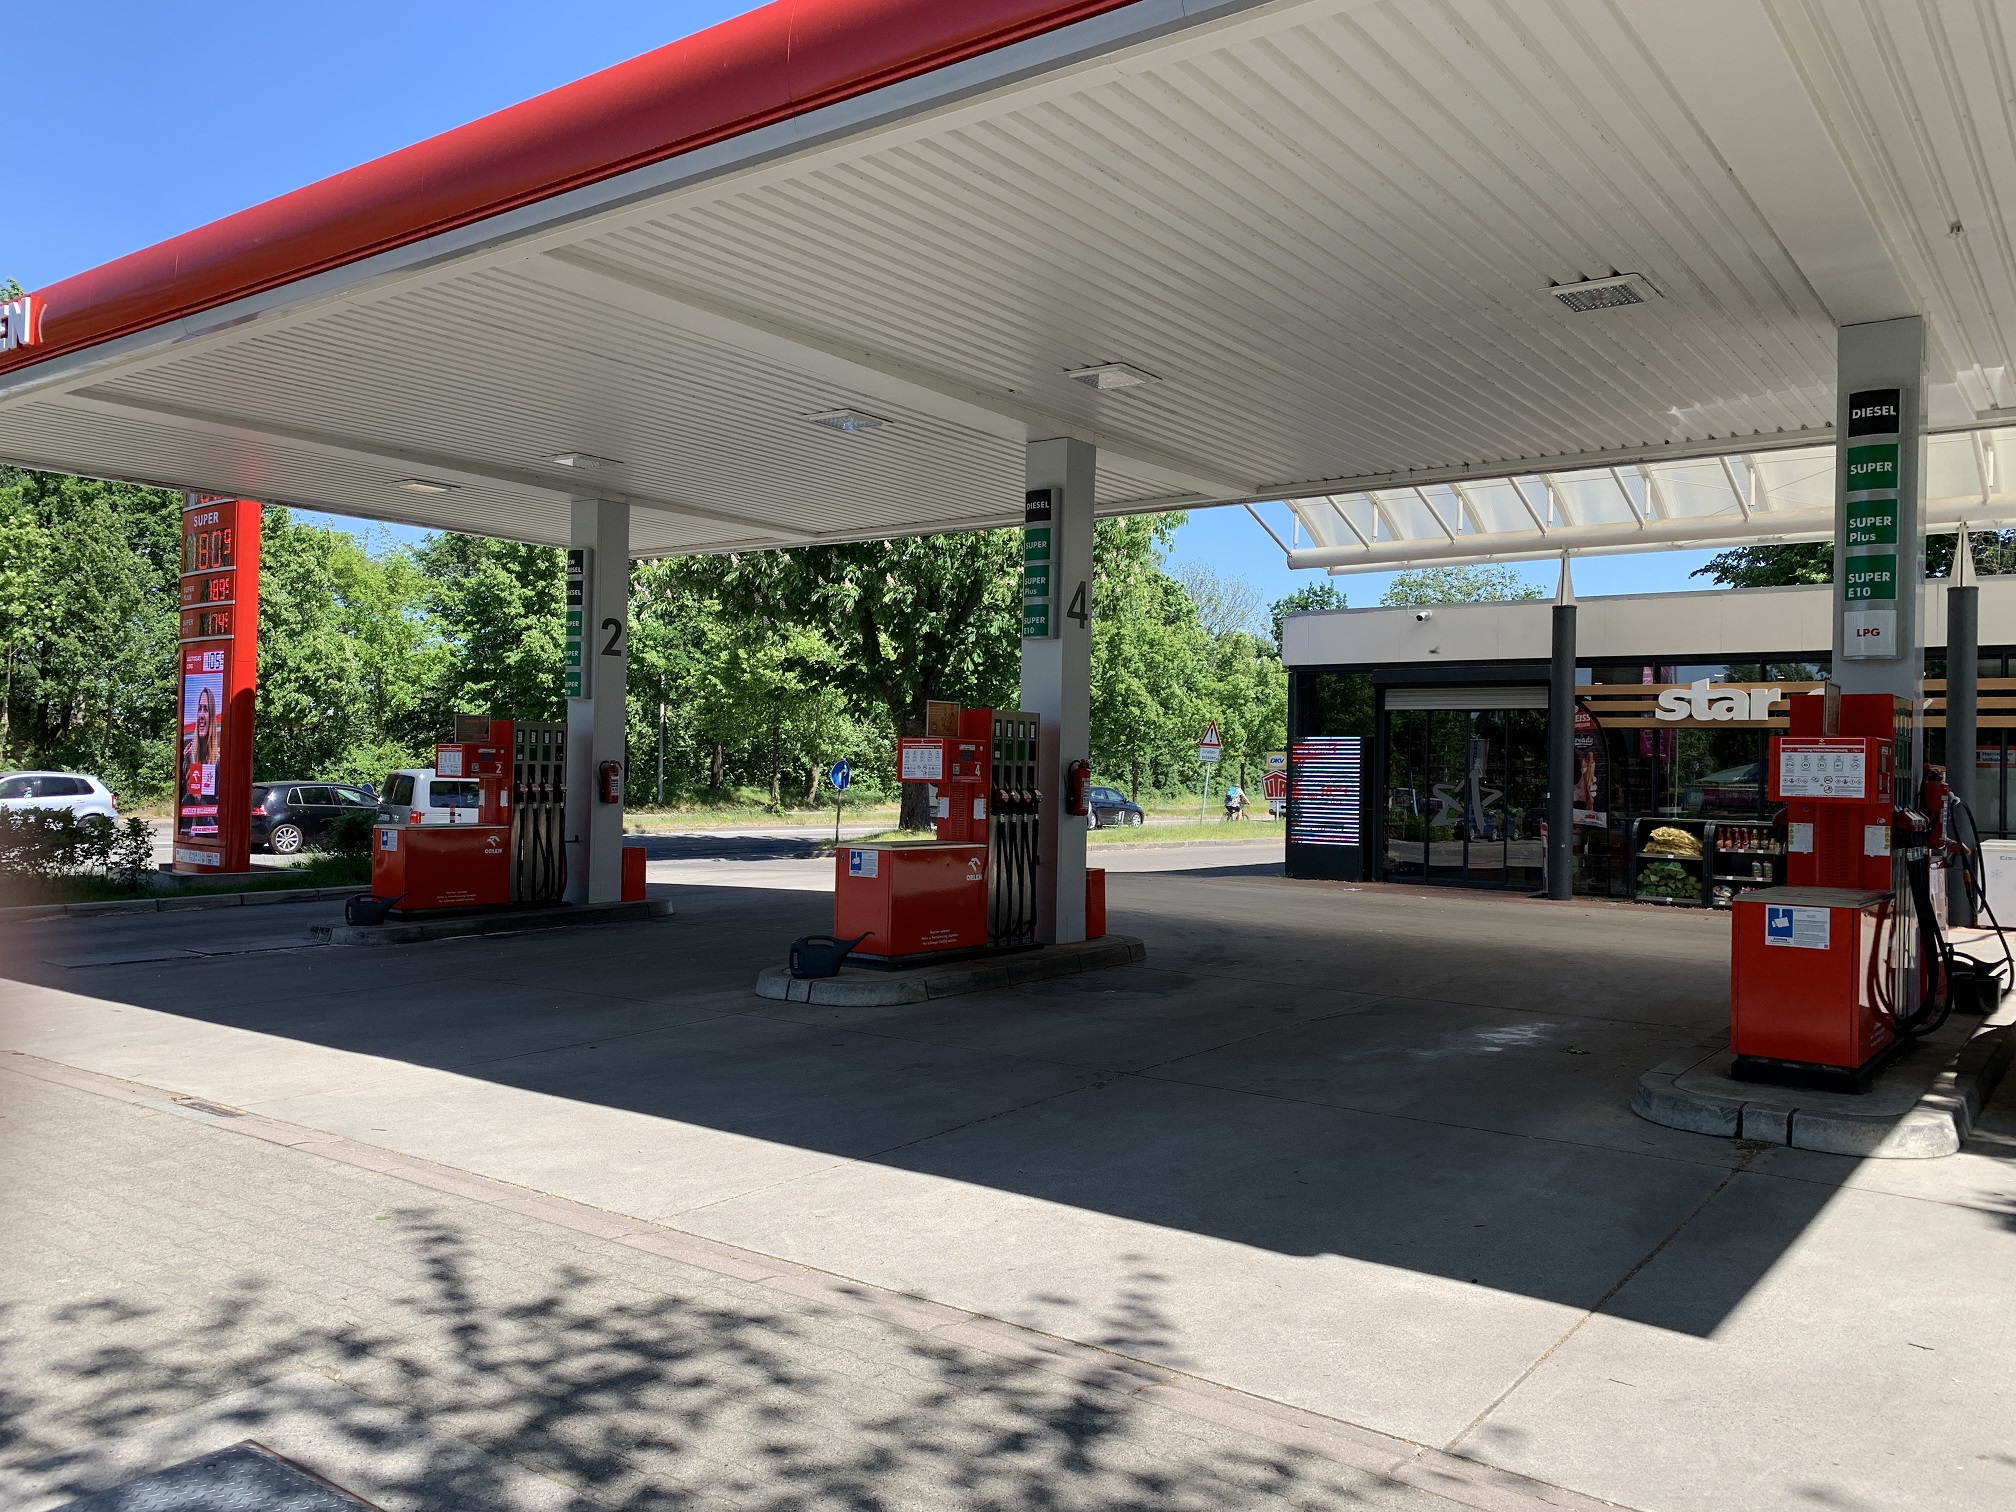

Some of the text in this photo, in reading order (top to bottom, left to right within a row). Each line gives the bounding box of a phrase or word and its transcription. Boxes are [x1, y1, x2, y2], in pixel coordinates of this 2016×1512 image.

[1851, 405, 1897, 419] DIESEL
[1850, 461, 1893, 475] SUPER
[1026, 500, 1050, 511] DIESEL
[193, 511, 219, 528] SUPER
[1849, 516, 1892, 528] SUPER
[1849, 532, 1877, 543] Plus
[1025, 540, 1048, 550] SUPER
[1024, 576, 1046, 586] SUPER
[1848, 571, 1891, 584] SUPER
[1024, 587, 1038, 596] Plus
[1848, 586, 1872, 598] E10
[1066, 580, 1088, 630] 4
[1023, 615, 1046, 625] SUPER
[1023, 626, 1035, 636] E10
[1856, 627, 1881, 638] LPG
[600, 617, 623, 658] 2
[1655, 678, 1782, 722] star
[1574, 713, 1591, 723] EISS
[496, 763, 502, 774] 2
[975, 764, 981, 777] 4
